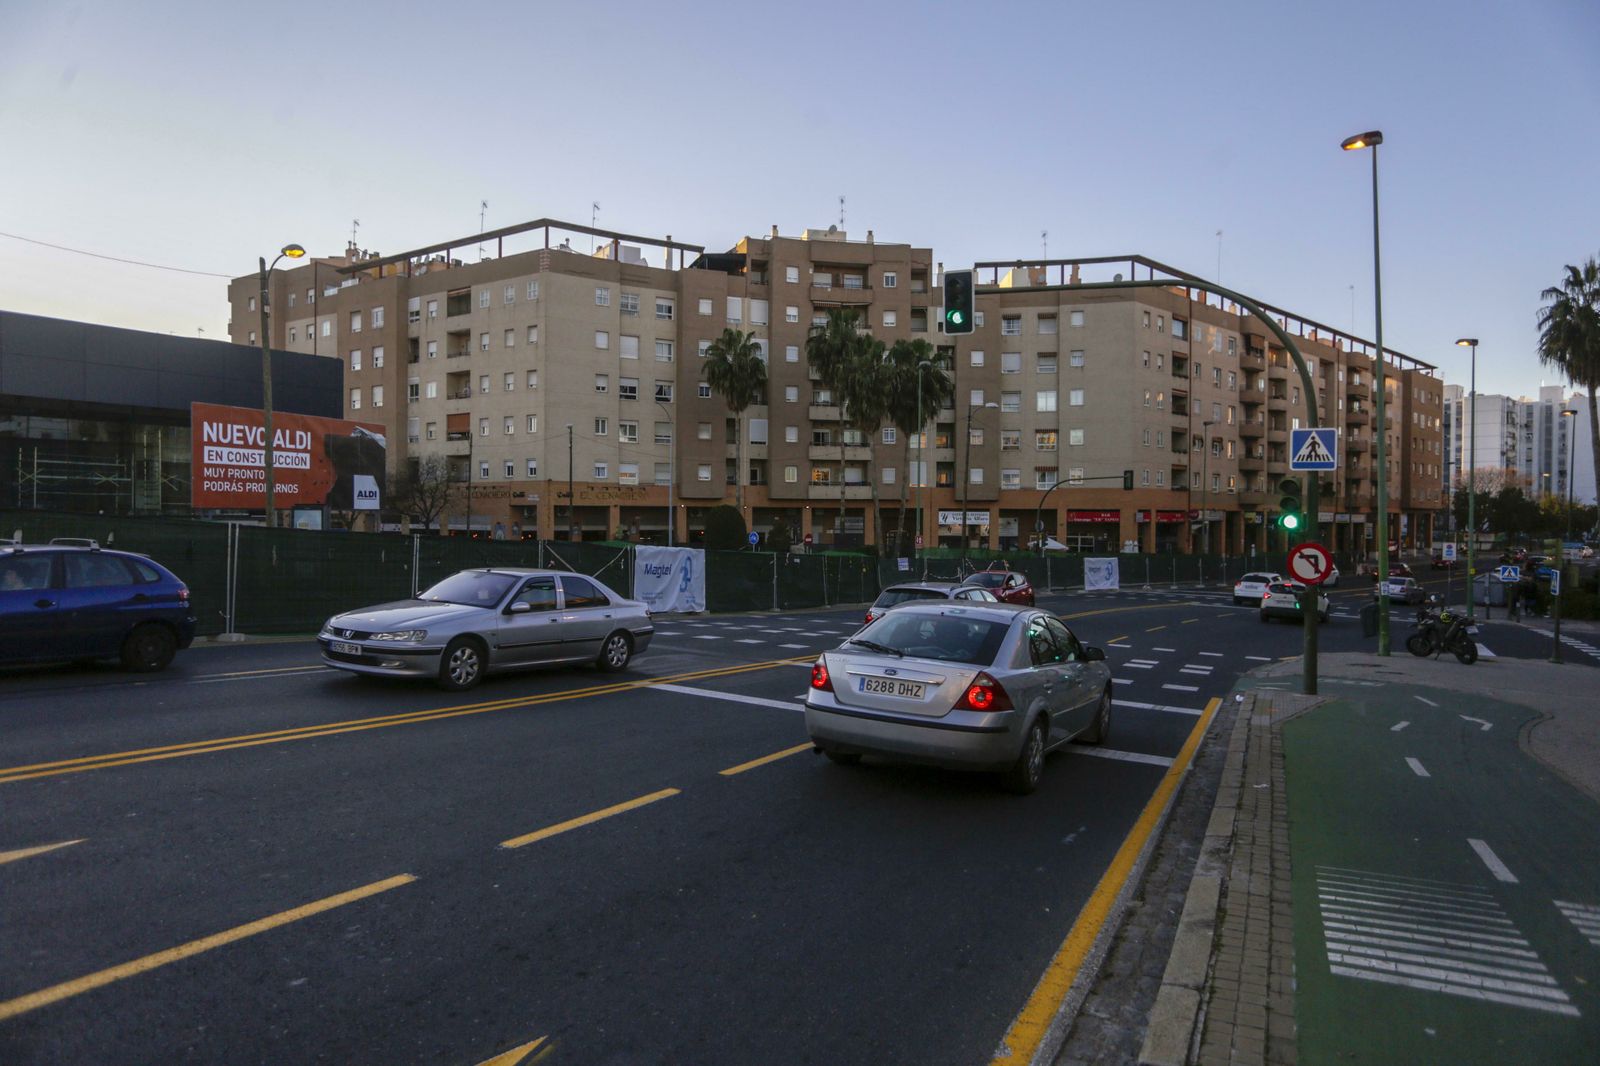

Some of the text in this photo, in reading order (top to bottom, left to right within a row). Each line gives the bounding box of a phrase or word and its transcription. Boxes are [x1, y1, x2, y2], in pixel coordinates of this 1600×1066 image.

[272, 428, 311, 450] ALDI
[207, 450, 307, 467] EN CONSTUCCIÓN
[203, 467, 265, 480] MUY PRONTO
[203, 480, 299, 494] PODRÁS PRORNOS
[356, 490, 377, 498] ALDI
[644, 563, 672, 578] Magtel
[865, 679, 921, 698] 6288 DHZ
